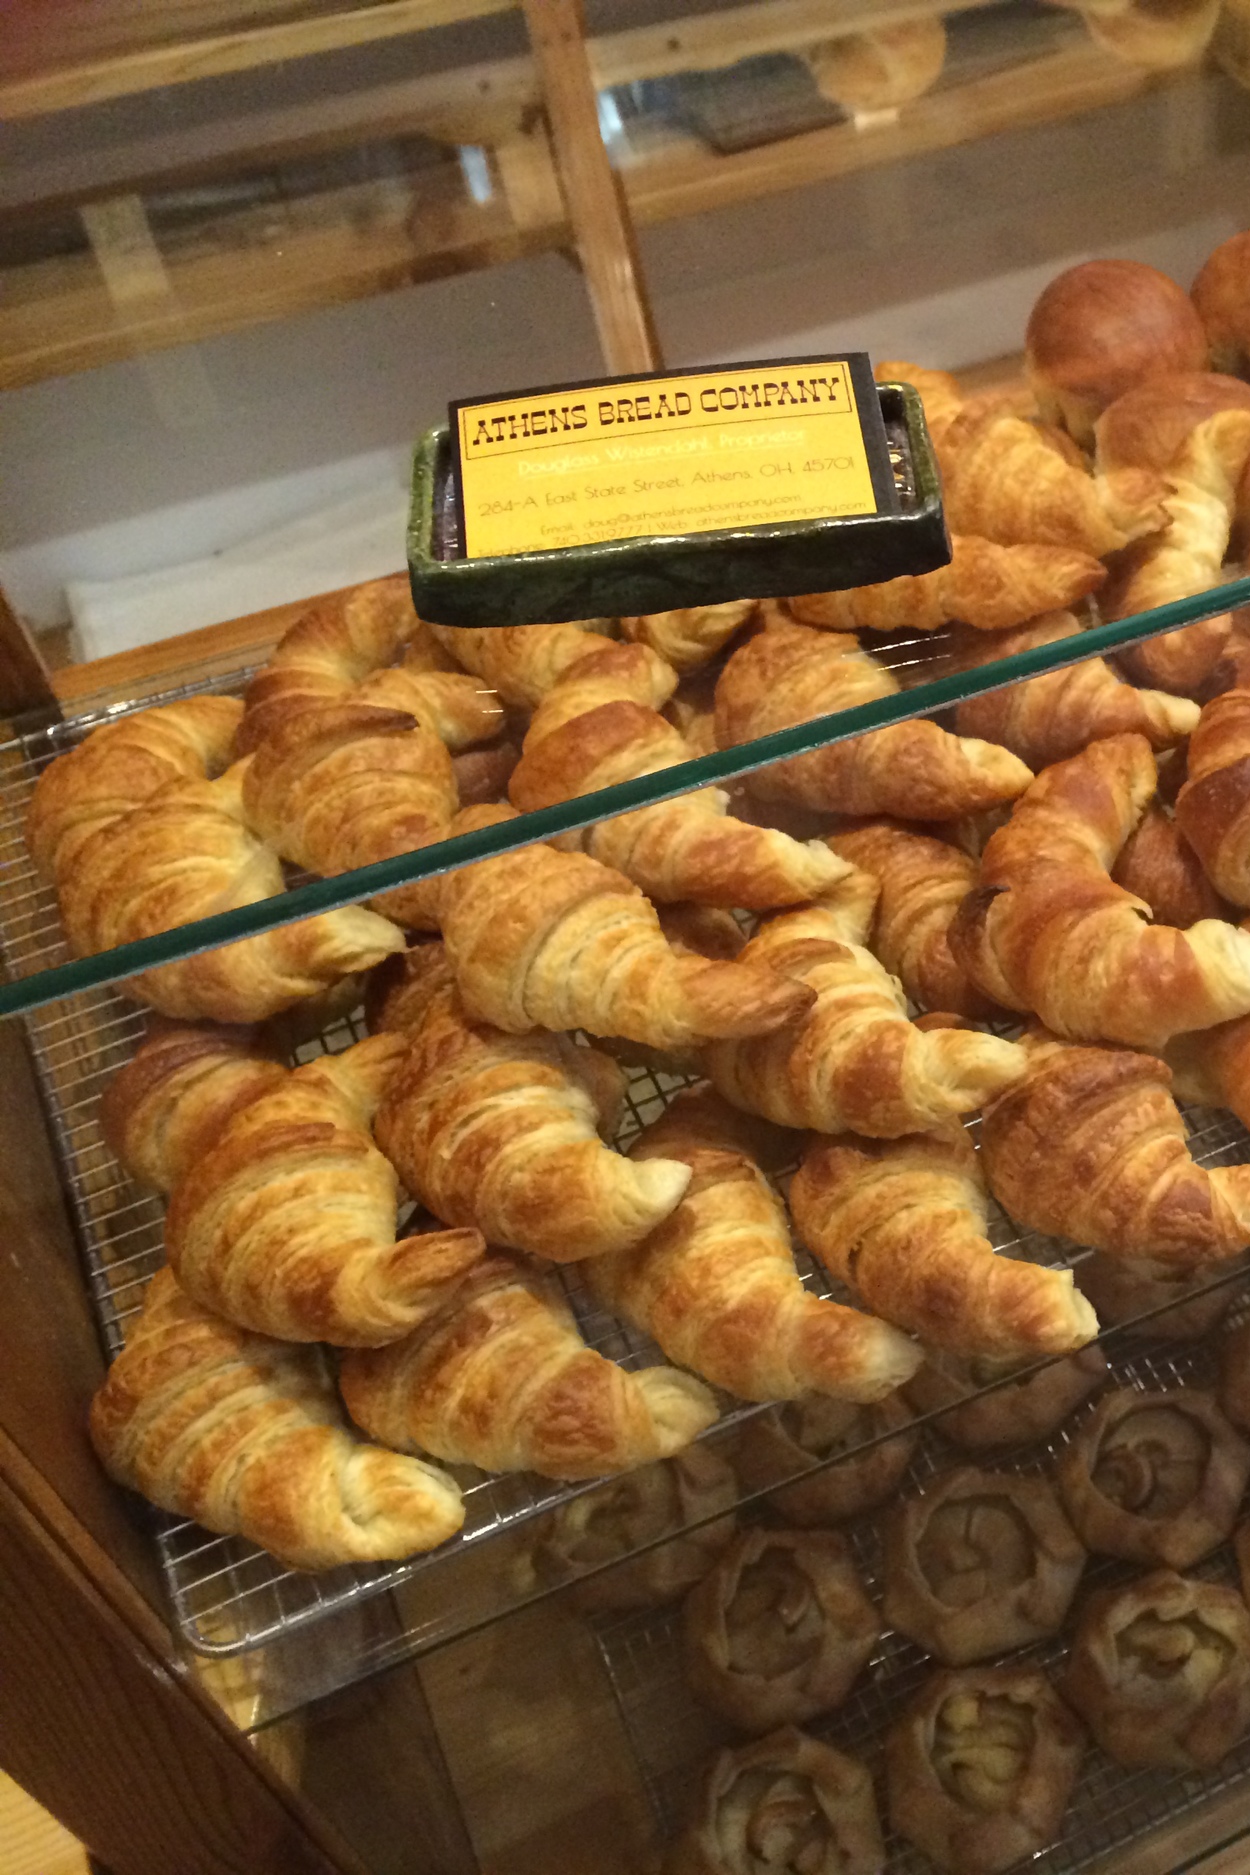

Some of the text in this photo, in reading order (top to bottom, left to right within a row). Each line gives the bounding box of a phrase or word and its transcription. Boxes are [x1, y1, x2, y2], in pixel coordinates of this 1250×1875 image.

[473, 376, 840, 446] ATHENS BREAD COMPANY
[478, 496, 539, 517] 284-A
[544, 490, 578, 507] East
[584, 484, 627, 501] State
[802, 455, 855, 474] 45701
